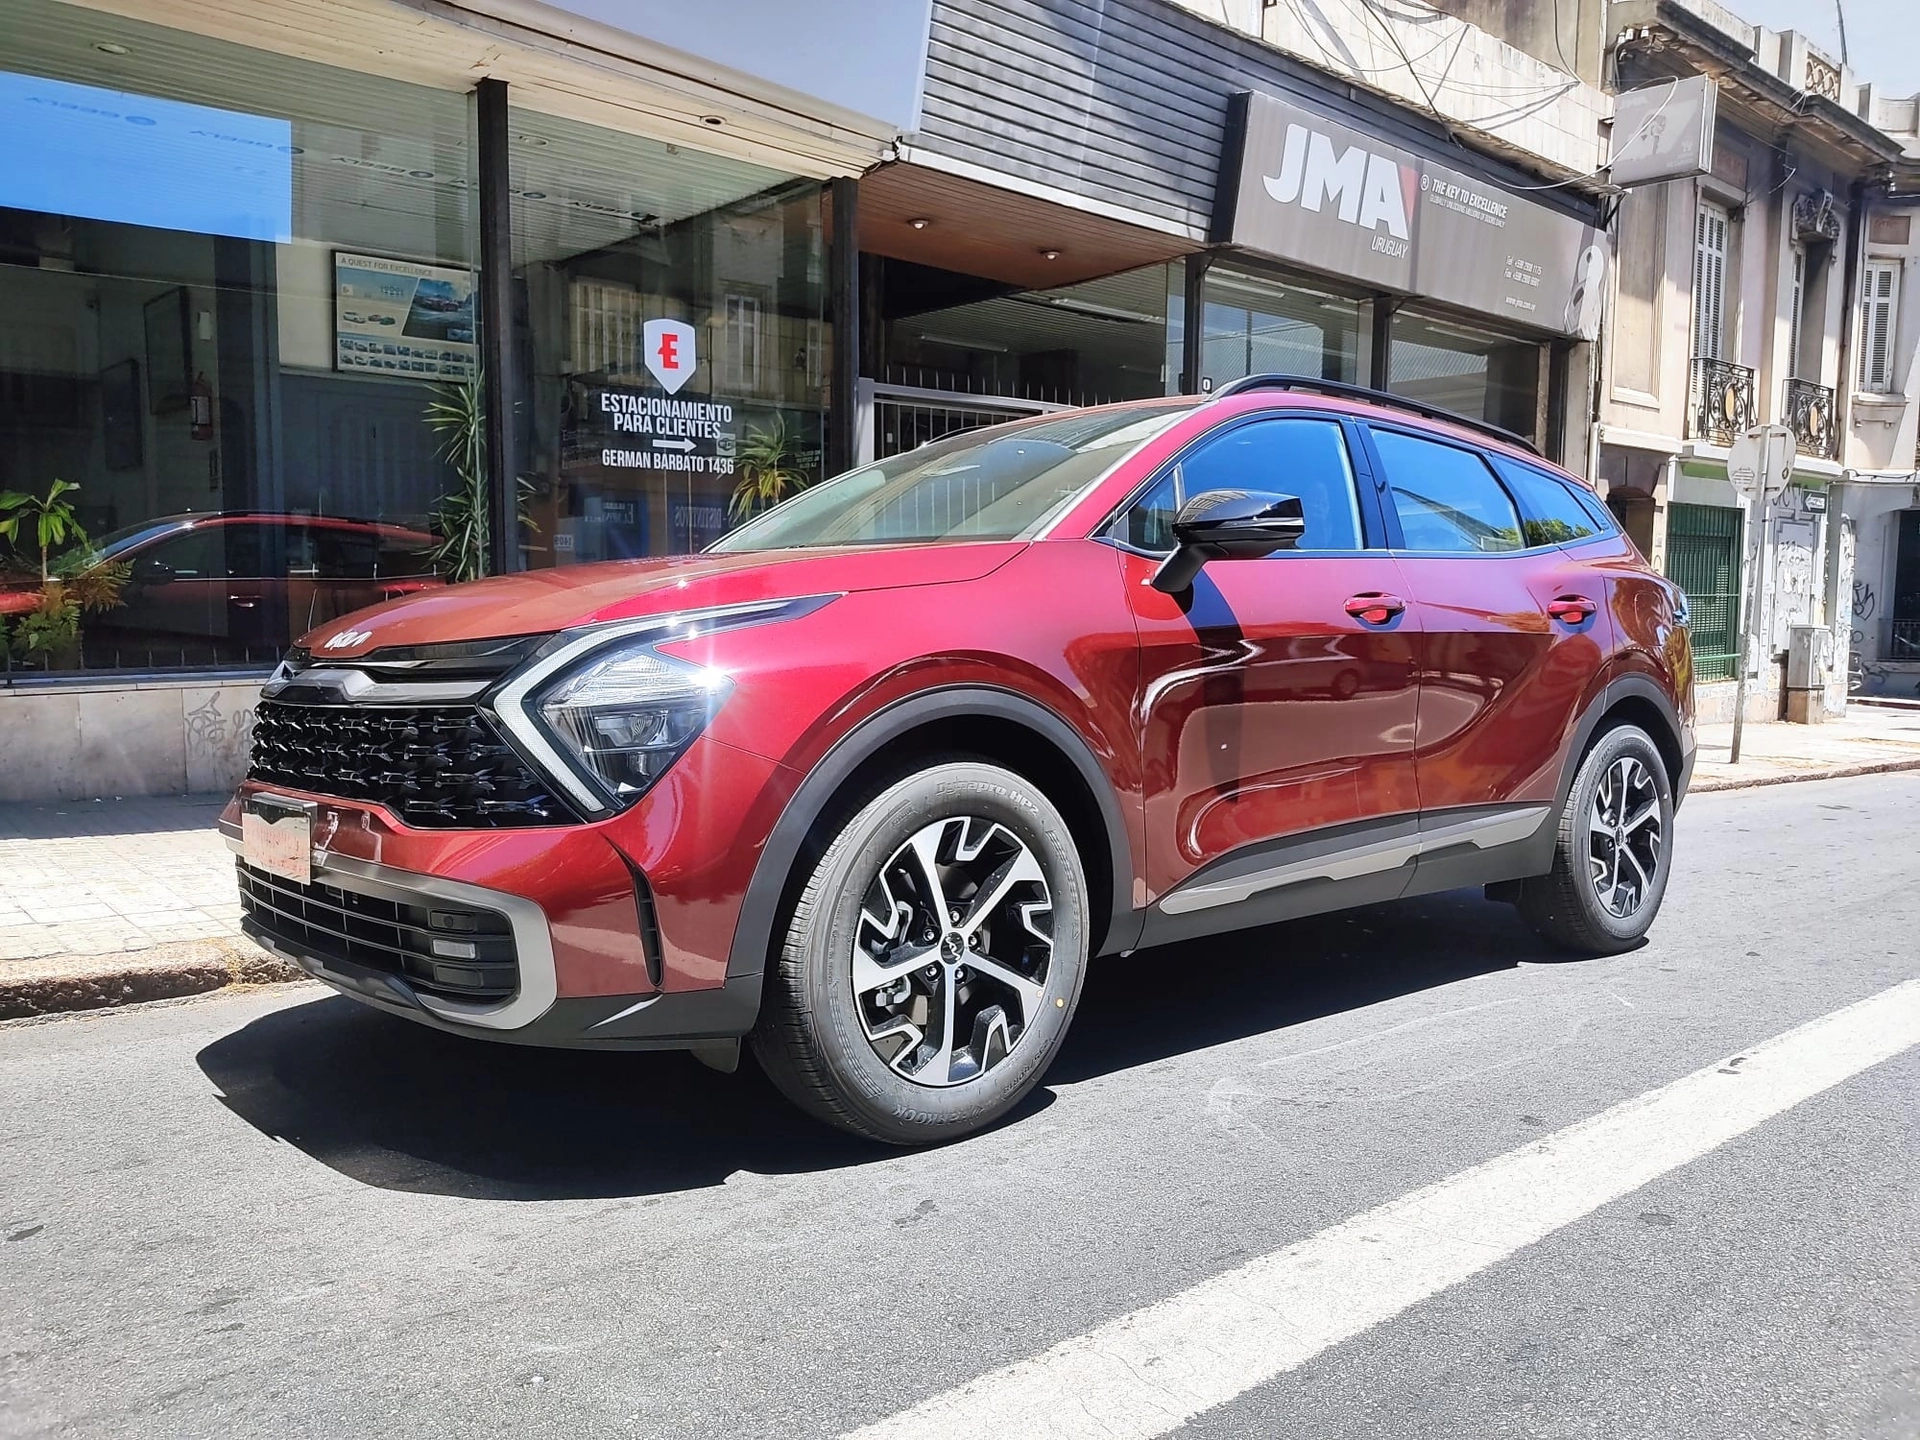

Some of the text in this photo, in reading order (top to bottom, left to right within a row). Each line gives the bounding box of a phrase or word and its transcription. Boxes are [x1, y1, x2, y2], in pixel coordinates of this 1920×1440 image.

[1262, 123, 1409, 240] JMA
[1432, 178, 1508, 219] THE KEY TO EXCELLENCE
[1371, 235, 1408, 259] URUGUAY
[340, 256, 433, 277] A QUEST FOR EXCELLENCE
[601, 393, 732, 422] ESTACIONAMIENTO
[613, 412, 721, 439] PARA CLIENTES
[602, 449, 734, 474] GERMAN BARBATO 1436
[1008, 790, 1039, 816] HP2
